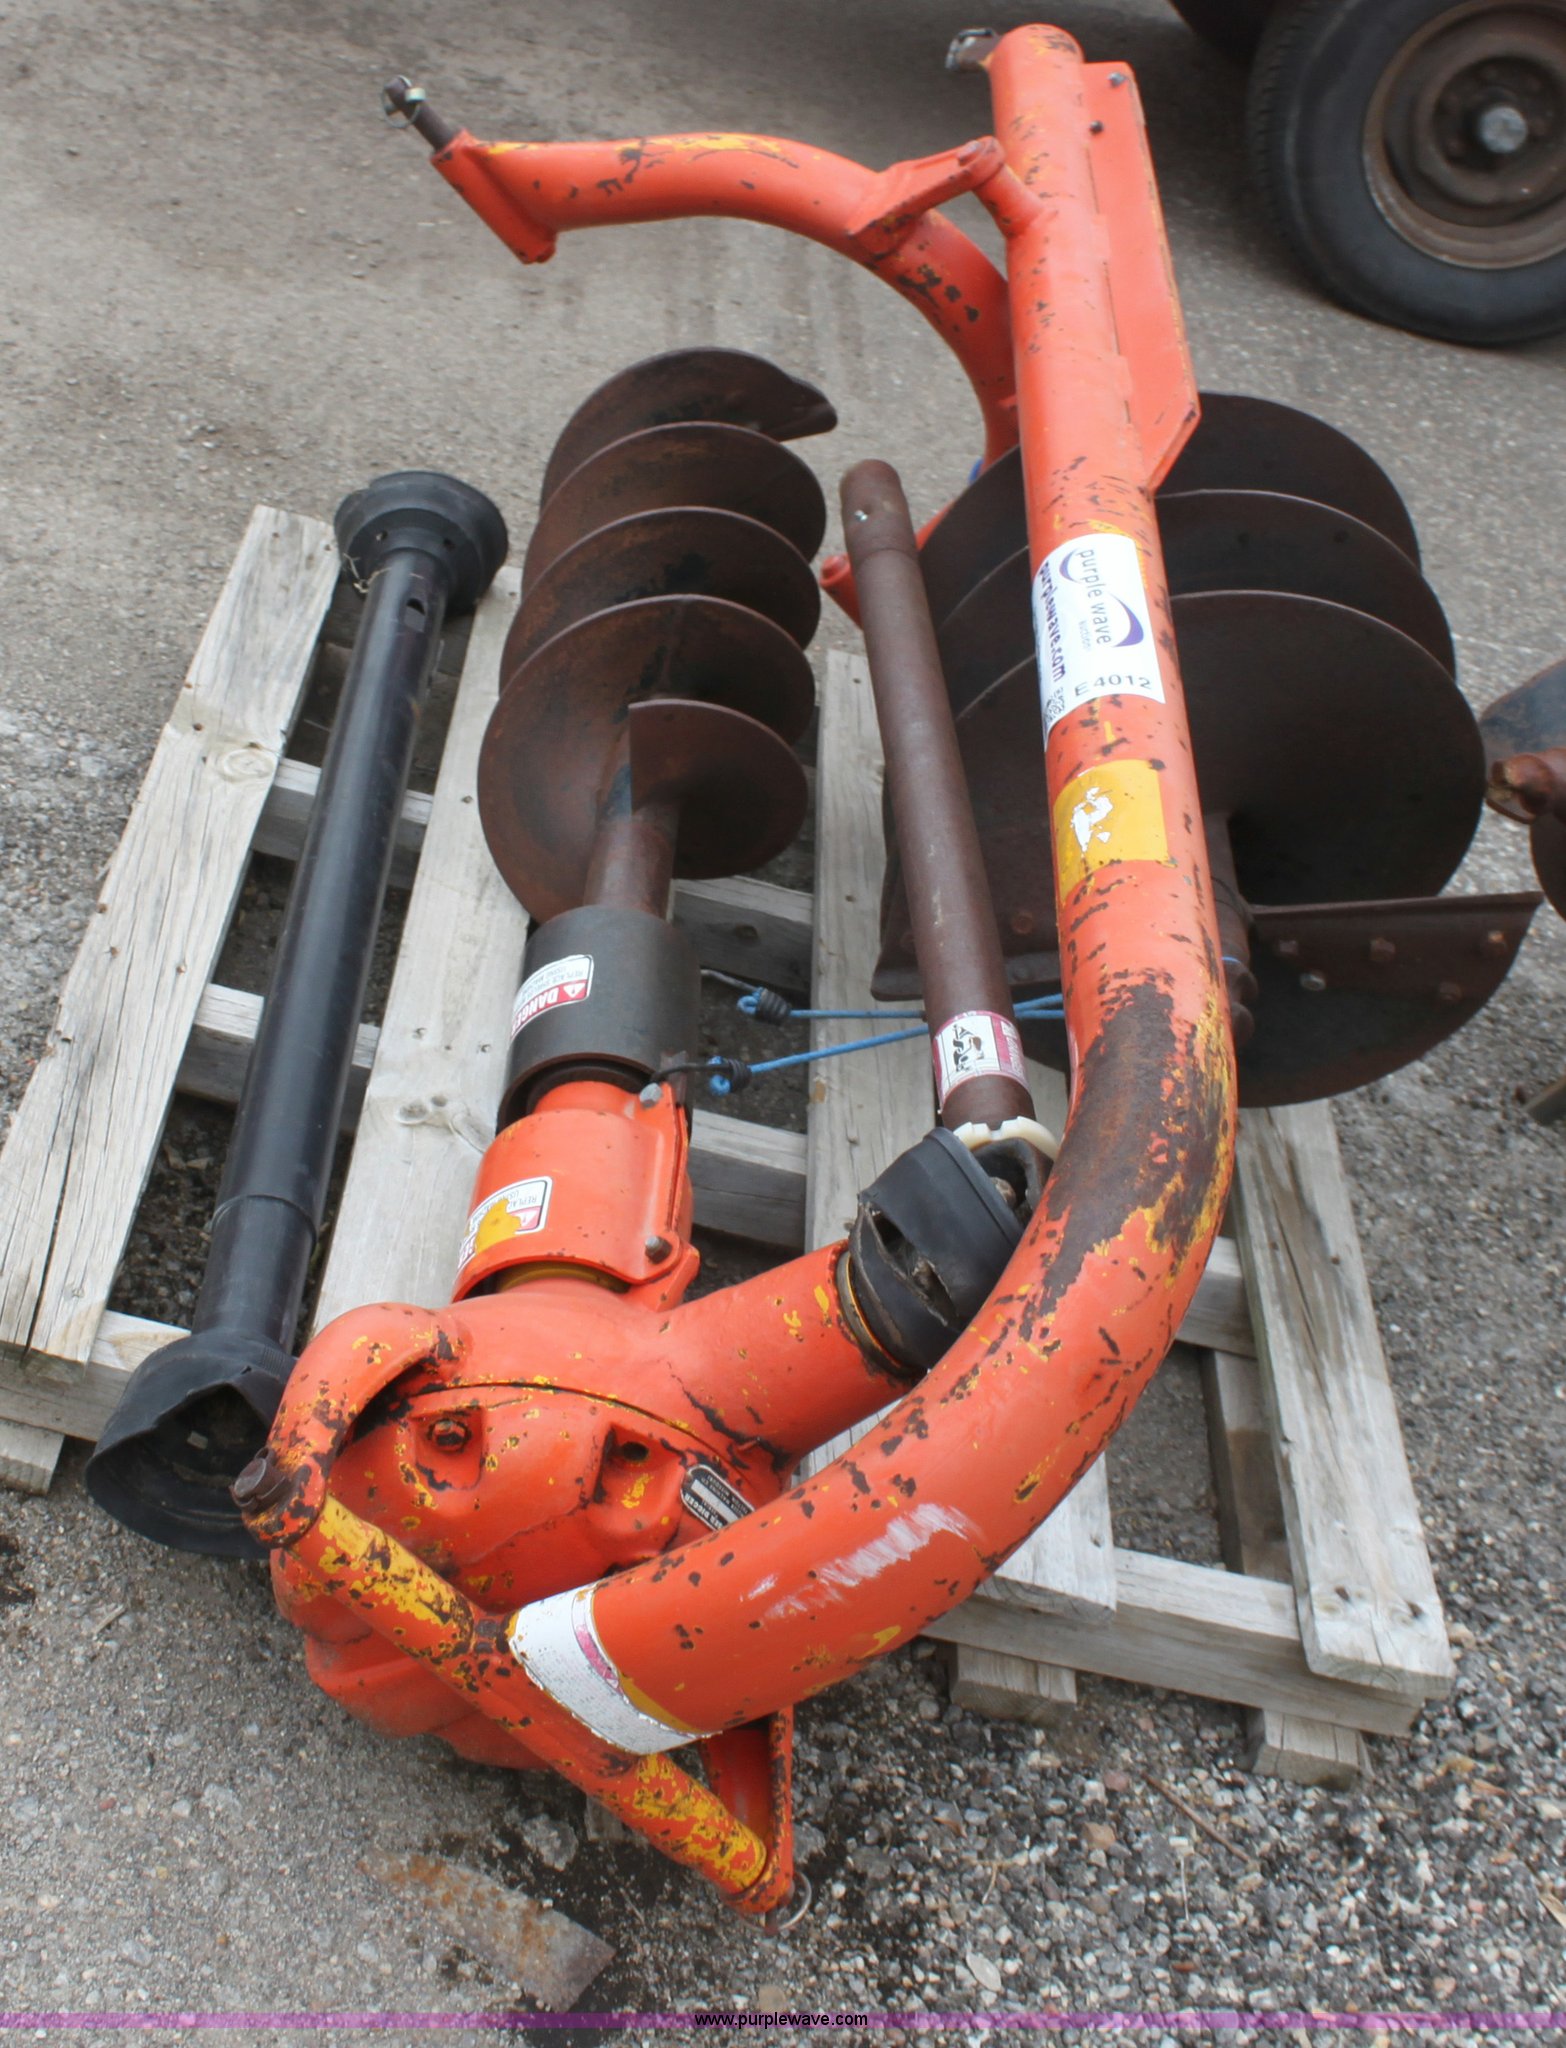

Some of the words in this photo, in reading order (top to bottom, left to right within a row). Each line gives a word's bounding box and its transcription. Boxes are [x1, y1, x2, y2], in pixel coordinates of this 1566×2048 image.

[1076, 549, 1106, 598] purple
[1039, 560, 1066, 682] purplewave.com
[1090, 602, 1112, 645] wave
[1074, 682, 1090, 696] E
[1094, 674, 1152, 690] 4012
